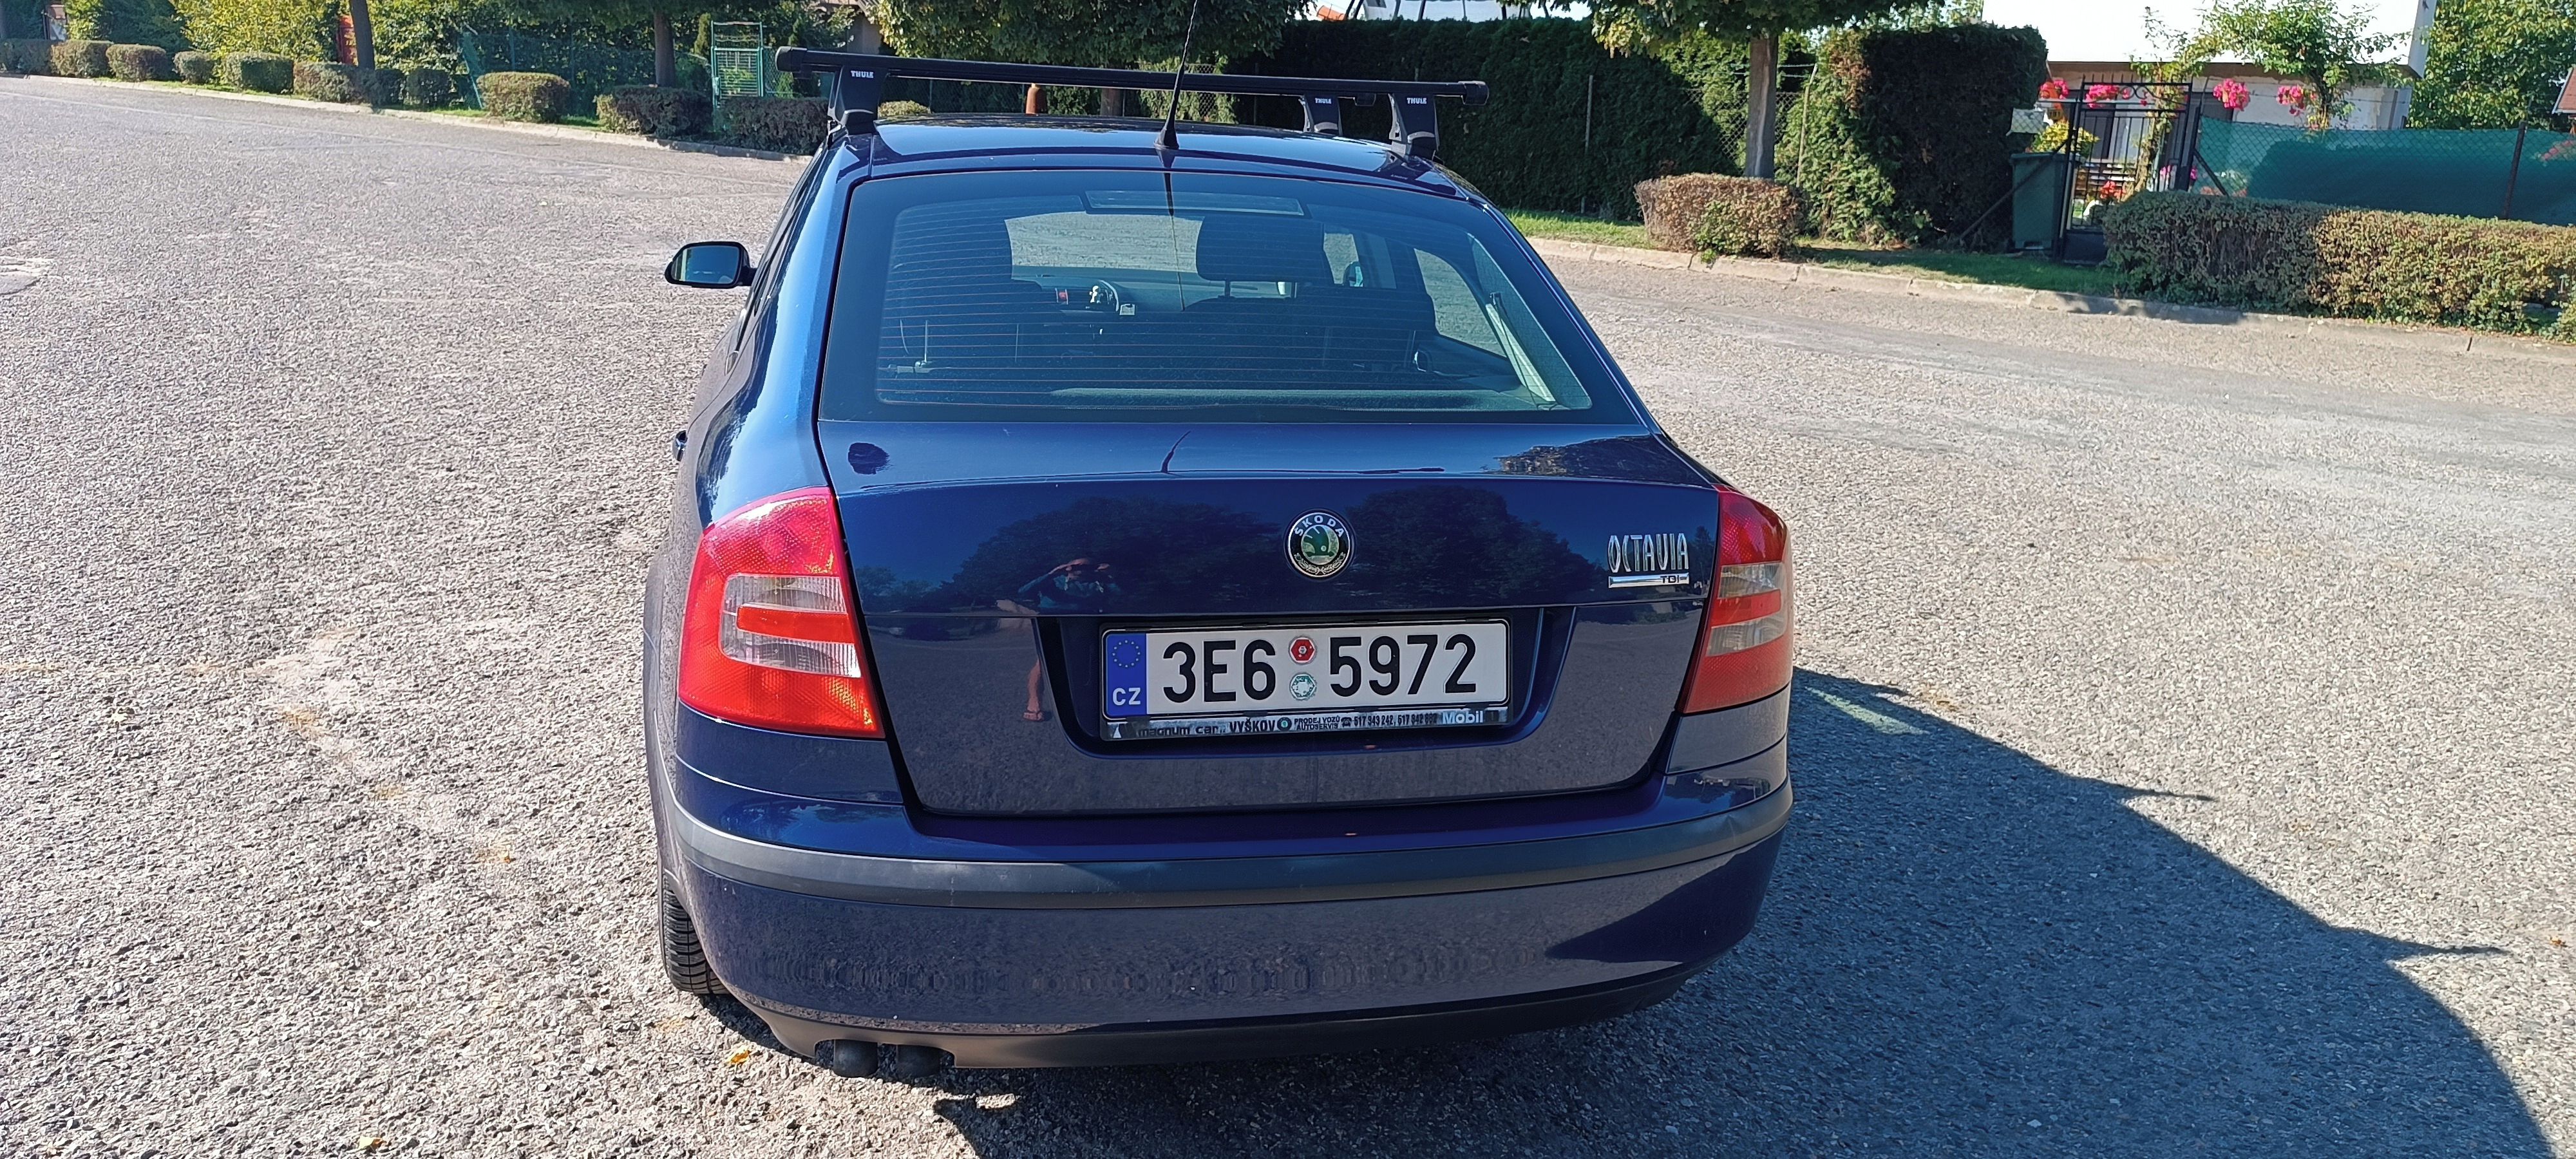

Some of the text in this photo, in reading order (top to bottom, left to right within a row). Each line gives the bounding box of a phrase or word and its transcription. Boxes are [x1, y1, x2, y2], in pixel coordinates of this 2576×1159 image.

[850, 70, 874, 79] THULE
[1607, 532, 1689, 573] OCTAVIA
[1660, 575, 1680, 583] TDI
[1162, 634, 1476, 703] 3E6 5972
[1112, 687, 1141, 706] CZ
[1442, 710, 1483, 724] Mobil
[1229, 717, 1276, 733] VYŠKOV
[1296, 722, 1338, 731] AUTOSERVIS
